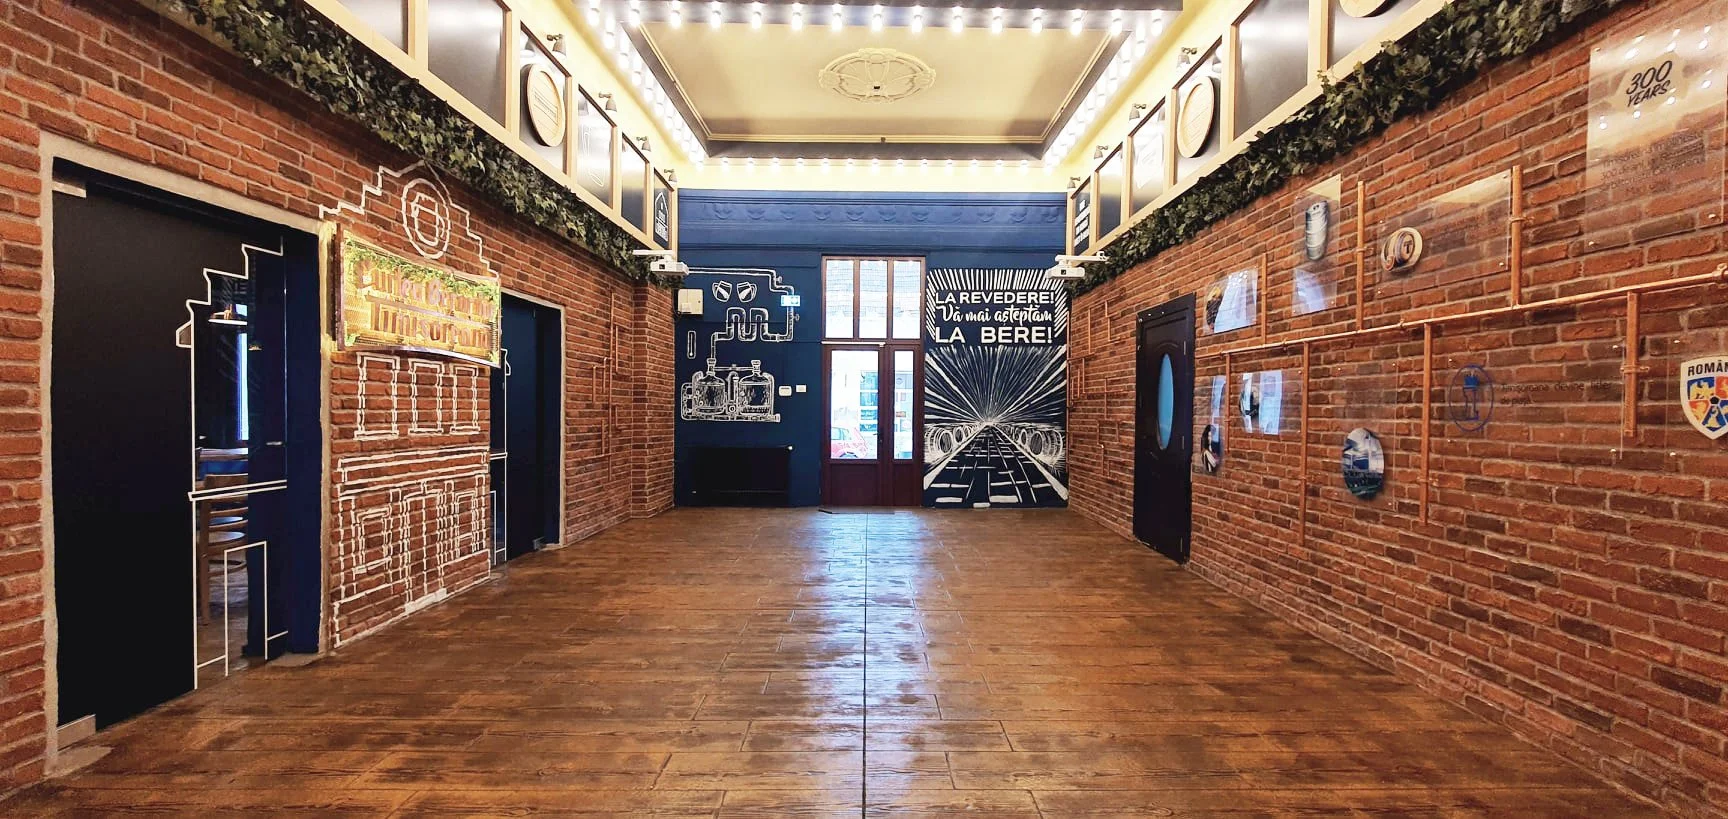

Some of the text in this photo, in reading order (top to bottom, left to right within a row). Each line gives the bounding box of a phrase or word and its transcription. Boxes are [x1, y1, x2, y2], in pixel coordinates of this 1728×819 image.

[1626, 60, 1673, 94] 300
[1627, 80, 1671, 107] YEARS
[936, 291, 1055, 304] LA REVEDERE!
[936, 304, 1053, 326] Vă mai așteptăm
[936, 326, 1053, 344] LA BERE!
